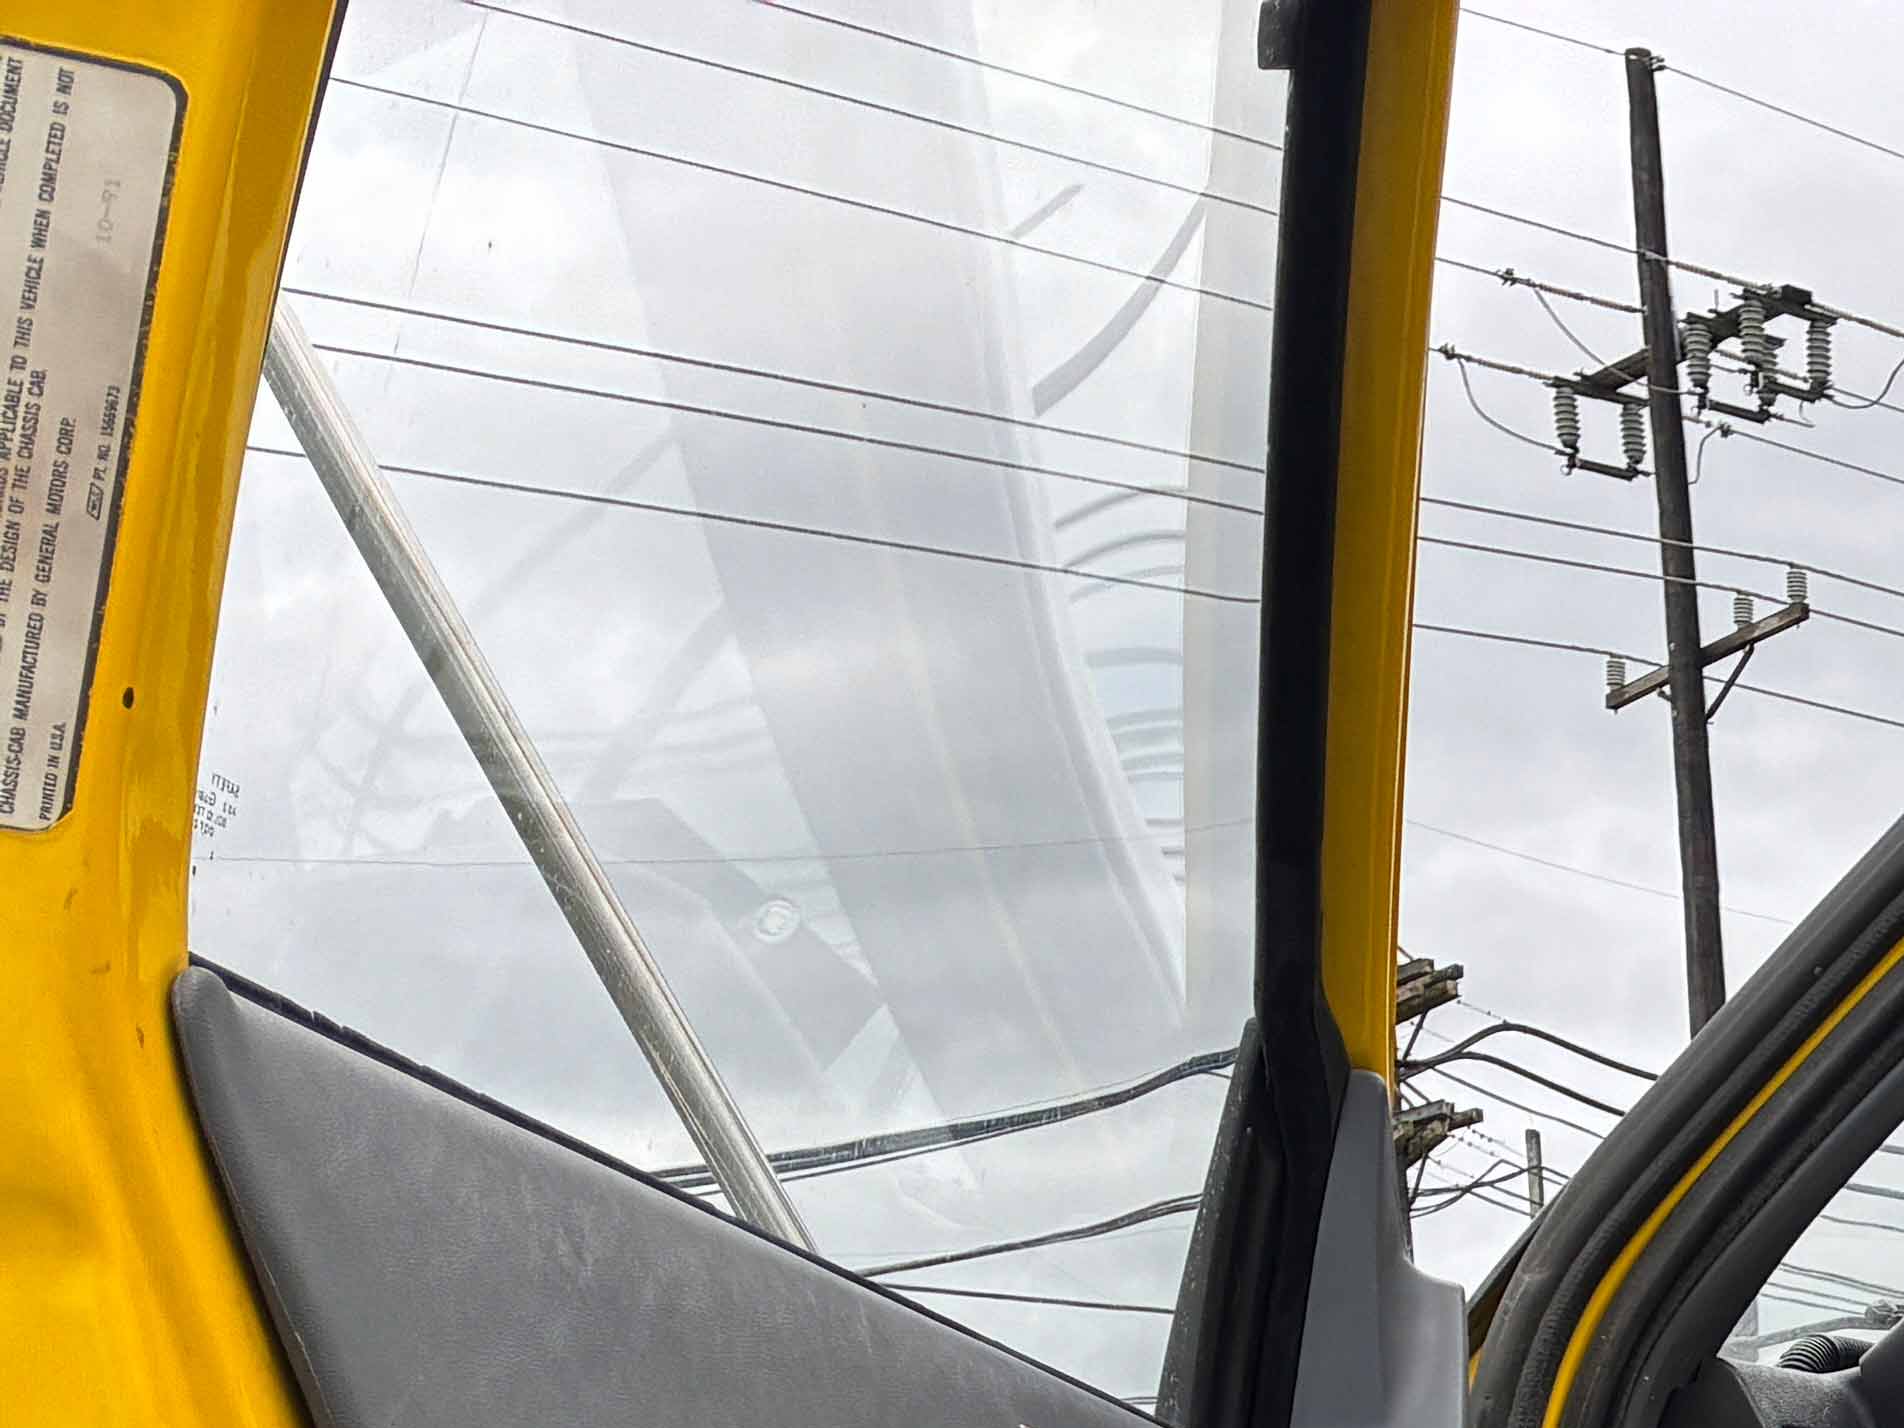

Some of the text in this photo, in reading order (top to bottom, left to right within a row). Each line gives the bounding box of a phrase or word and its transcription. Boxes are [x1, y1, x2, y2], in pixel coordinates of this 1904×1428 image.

[0, 57, 23, 133] DOCUMENT
[56, 67, 75, 96] NOT
[52, 100, 68, 116] IS
[38, 122, 66, 202] COMPLETED
[30, 209, 51, 249] WHEN
[20, 254, 44, 310] VEHICLE
[13, 317, 33, 348] THIS
[10, 356, 26, 372] TO
[0, 380, 24, 460] APPLICABLE
[17, 403, 41, 460] CHASSIS
[12, 464, 31, 491] THE
[9, 496, 25, 515] OF
[0, 521, 21, 573] DESIGN
[0, 416, 76, 815] CHASSIS-CAB MANUFACTURED BY GENERAL MOTORS CORP.
[46, 756, 60, 769] IN
[38, 773, 58, 822] PRINTED
